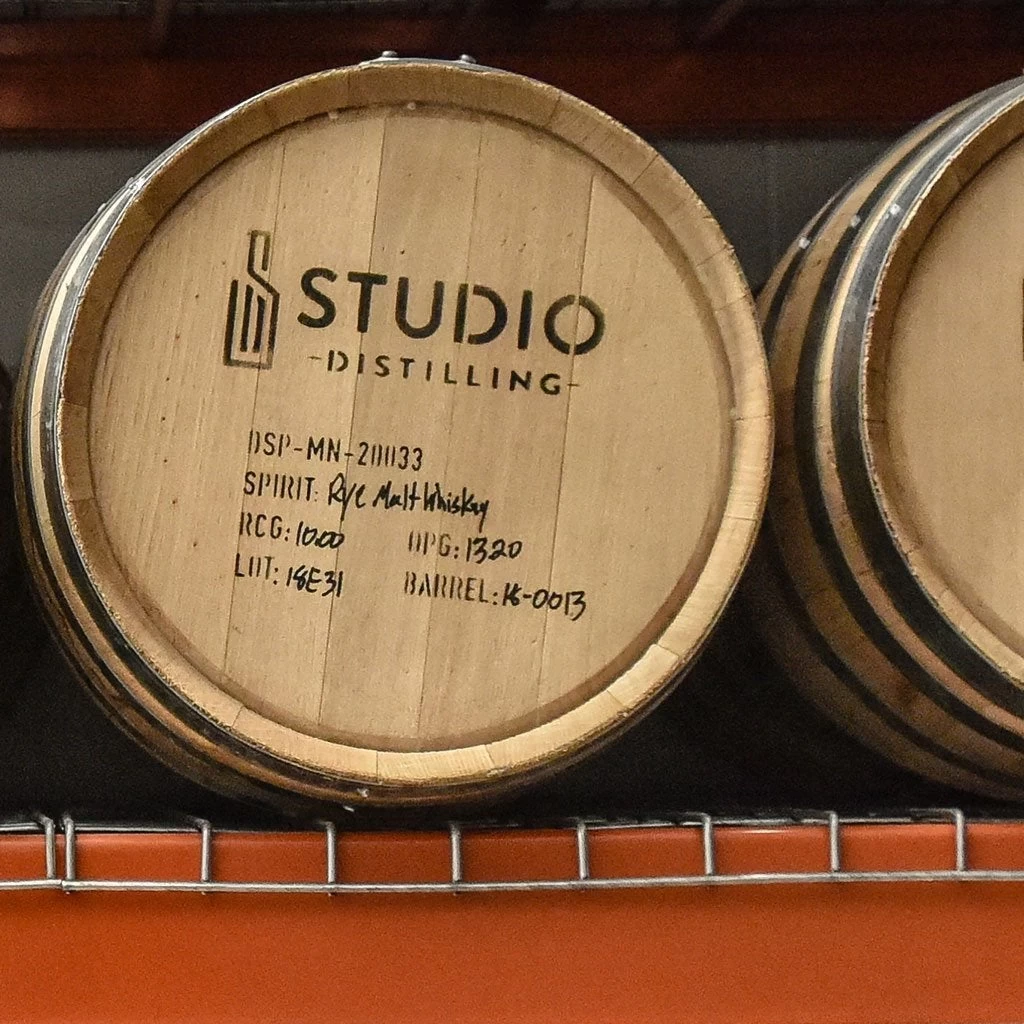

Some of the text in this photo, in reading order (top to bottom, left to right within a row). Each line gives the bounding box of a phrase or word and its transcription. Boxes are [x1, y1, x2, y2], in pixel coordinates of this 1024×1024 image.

[296, 266, 606, 356] STUDIO
[243, 471, 318, 502] SPIRIT:
[327, 472, 366, 522] Rye
[372, 480, 421, 511] Malt
[239, 512, 290, 542] RCG:
[403, 571, 498, 606] BARREL:
